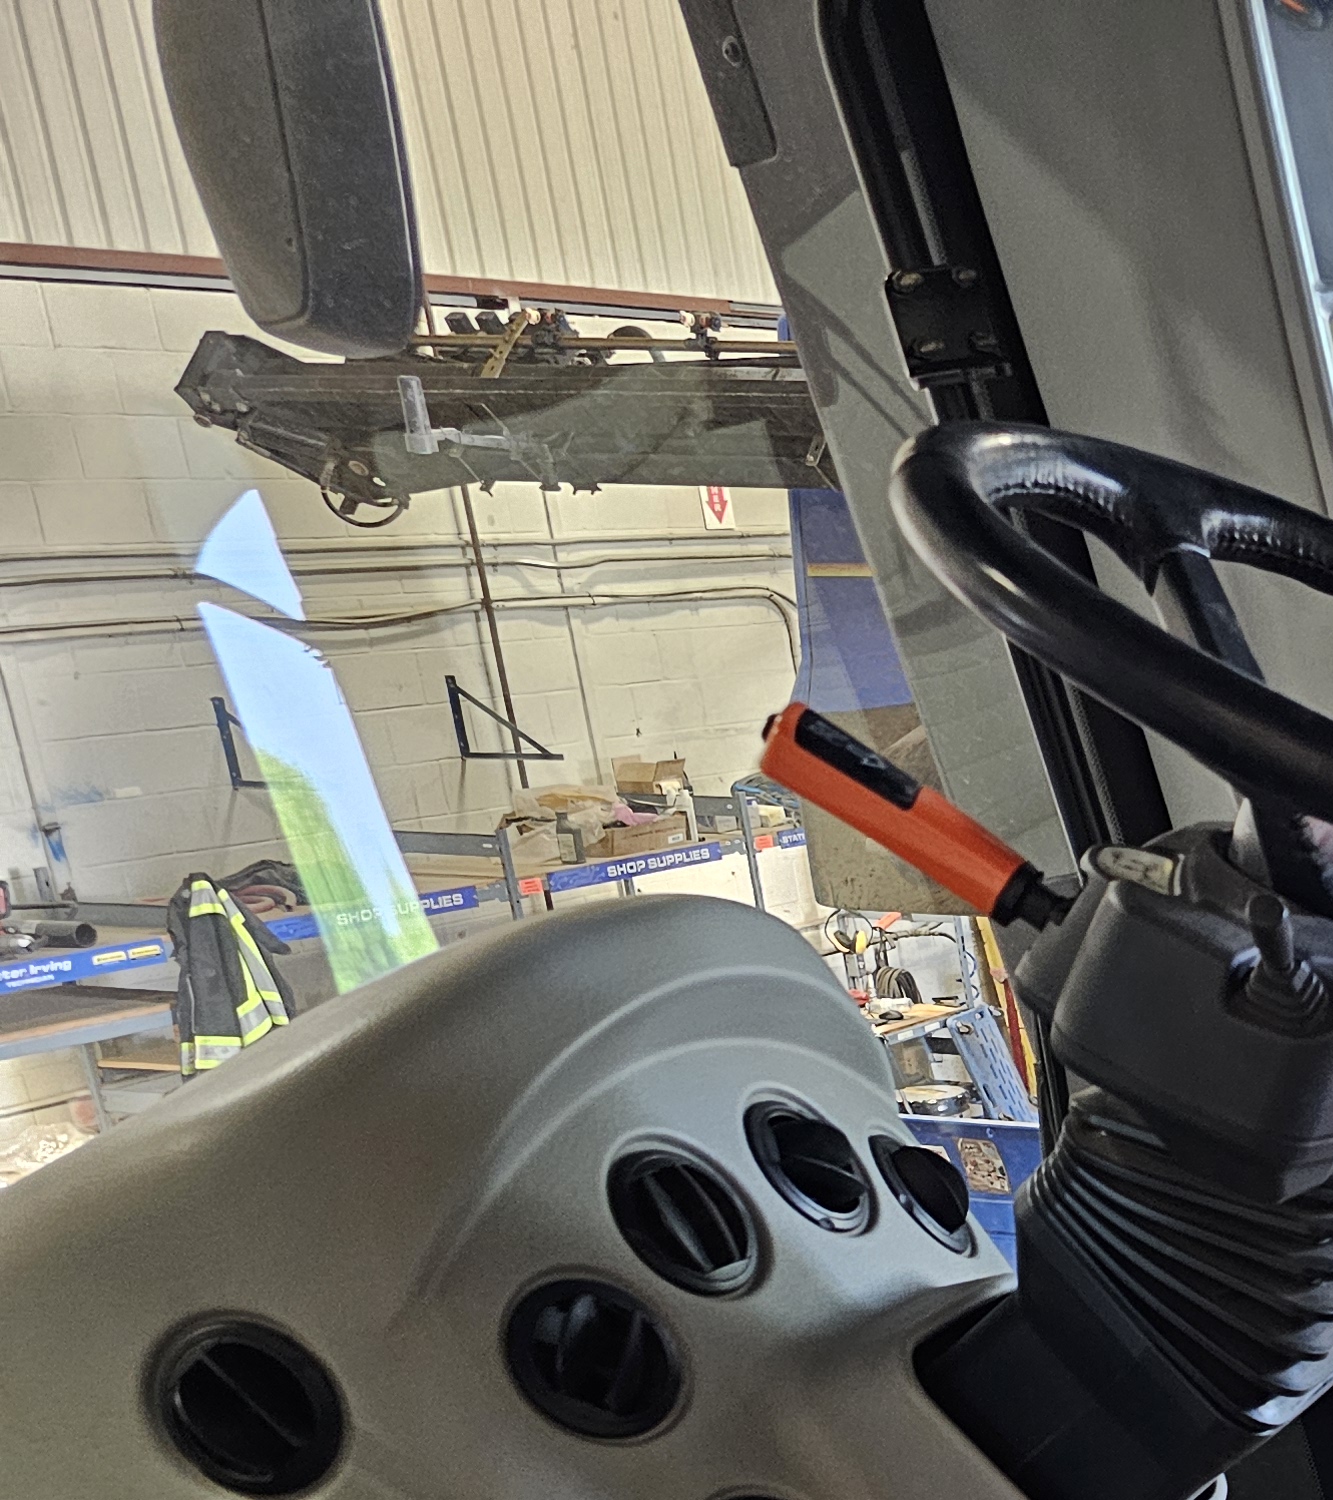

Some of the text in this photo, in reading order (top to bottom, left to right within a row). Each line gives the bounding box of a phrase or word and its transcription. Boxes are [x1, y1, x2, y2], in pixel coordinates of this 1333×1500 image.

[606, 848, 710, 878] SHOP SUPPLIES
[29, 960, 72, 976] Irving
